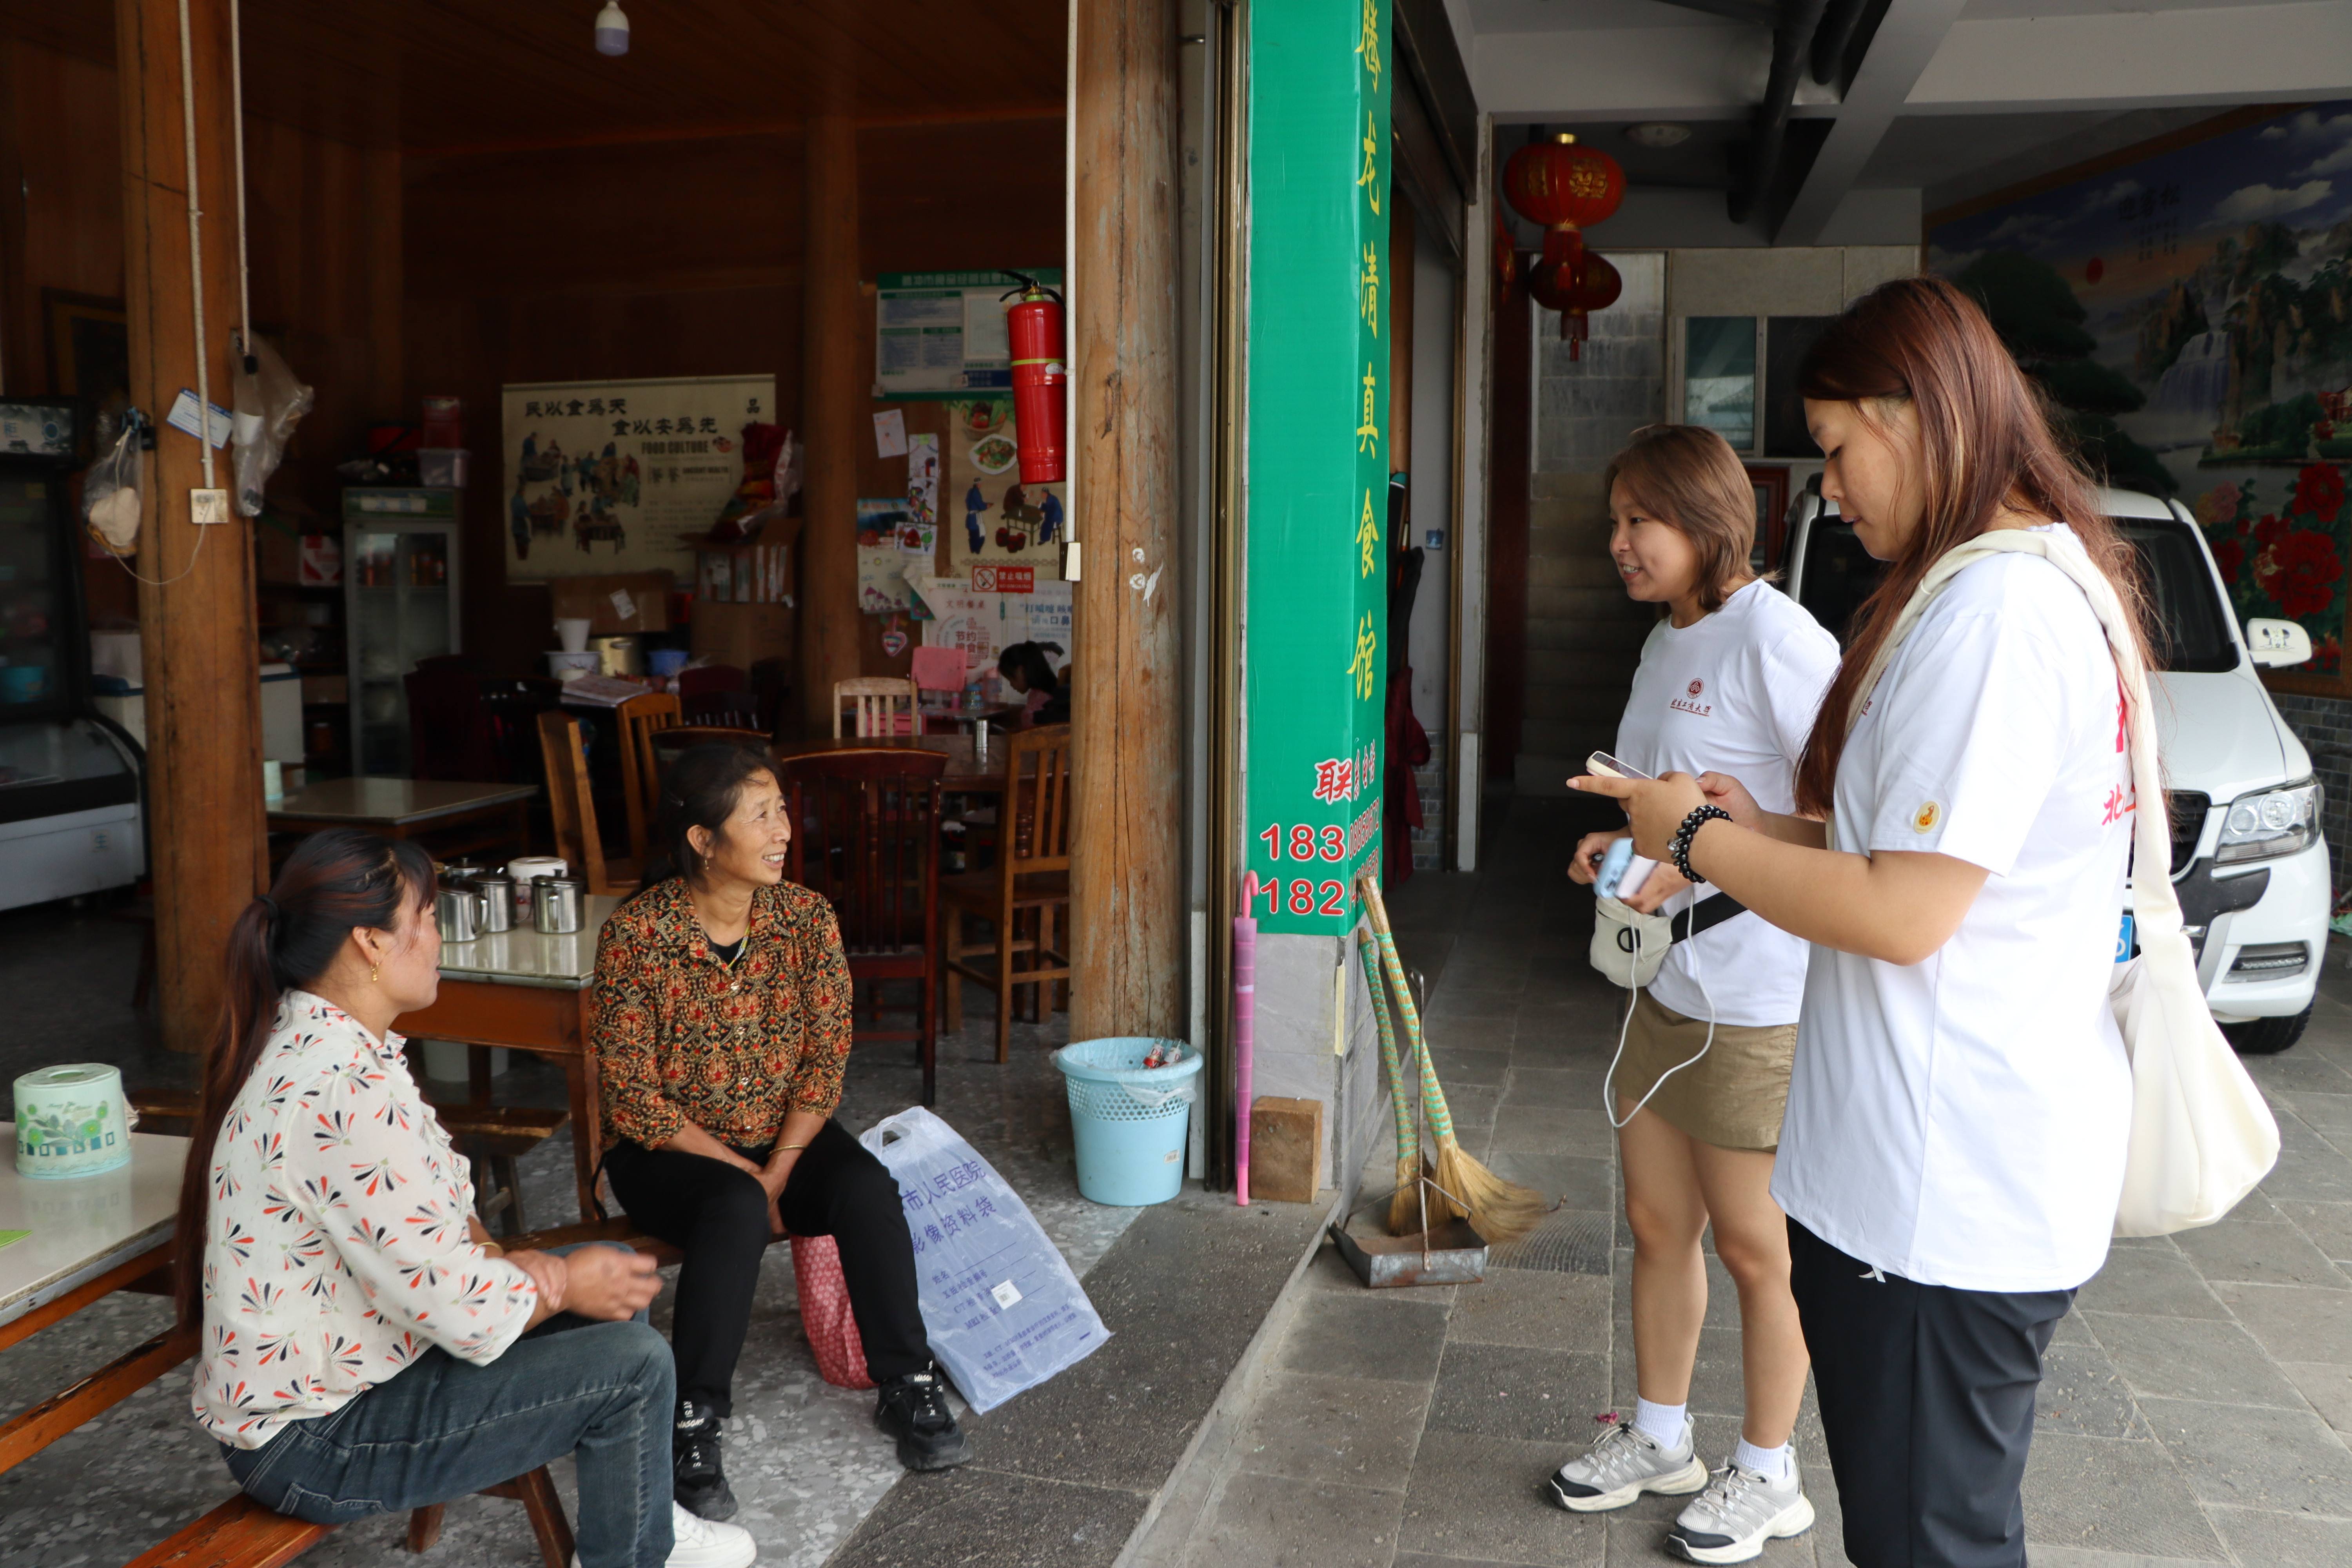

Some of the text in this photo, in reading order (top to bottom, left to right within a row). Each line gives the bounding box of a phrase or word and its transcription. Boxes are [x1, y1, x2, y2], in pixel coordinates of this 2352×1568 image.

[642, 441, 708, 454] FOOD CULTURE
[998, 571, 1031, 581] 禁止吸烟
[955, 630, 976, 641] 节约
[1670, 698, 1712, 715] 北京工商大学
[901, 1159, 986, 1211] 市人民医院
[932, 1270, 950, 1285] 姓名
